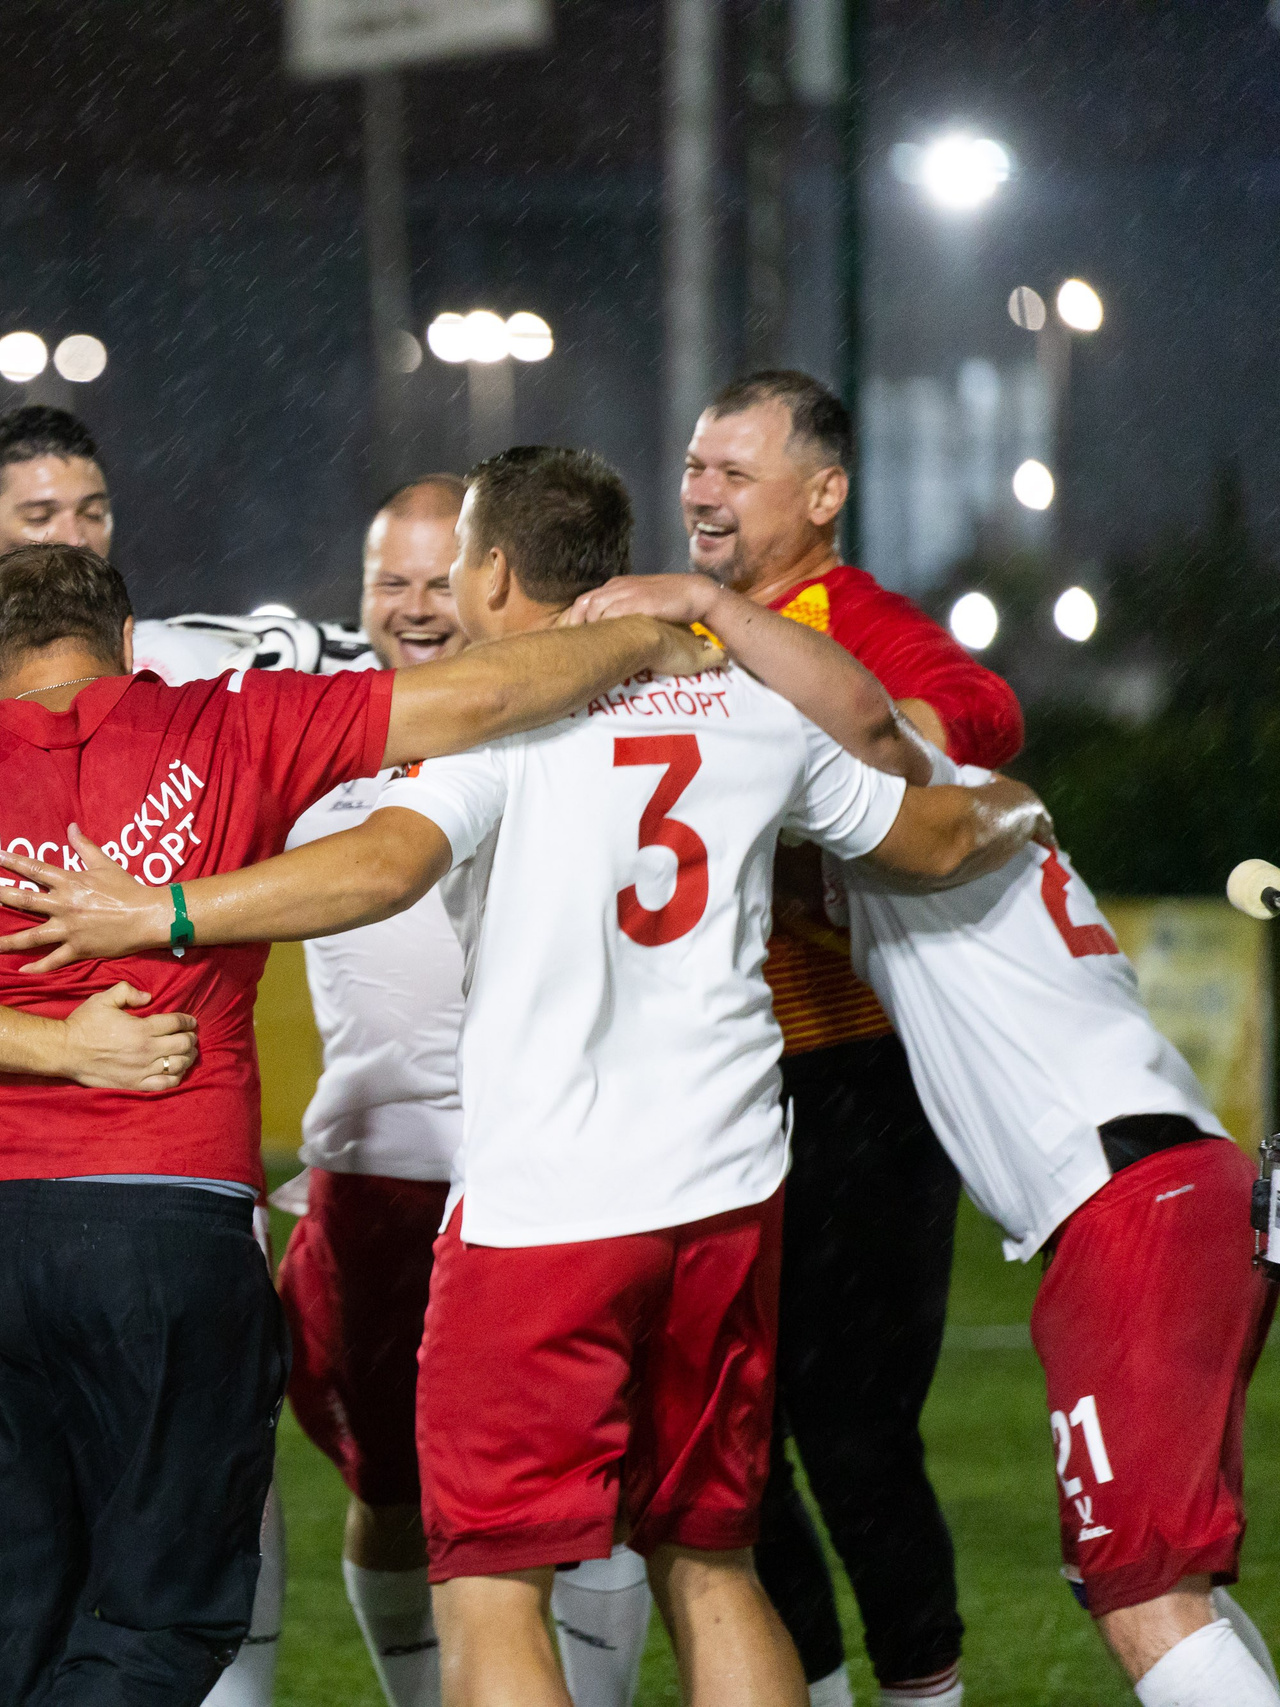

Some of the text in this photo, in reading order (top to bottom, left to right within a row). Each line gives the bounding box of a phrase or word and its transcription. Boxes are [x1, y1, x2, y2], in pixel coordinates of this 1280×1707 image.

[570, 690, 730, 718] АНСПОРТ
[613, 734, 710, 948] 3
[1051, 1395, 1114, 1498] 21
